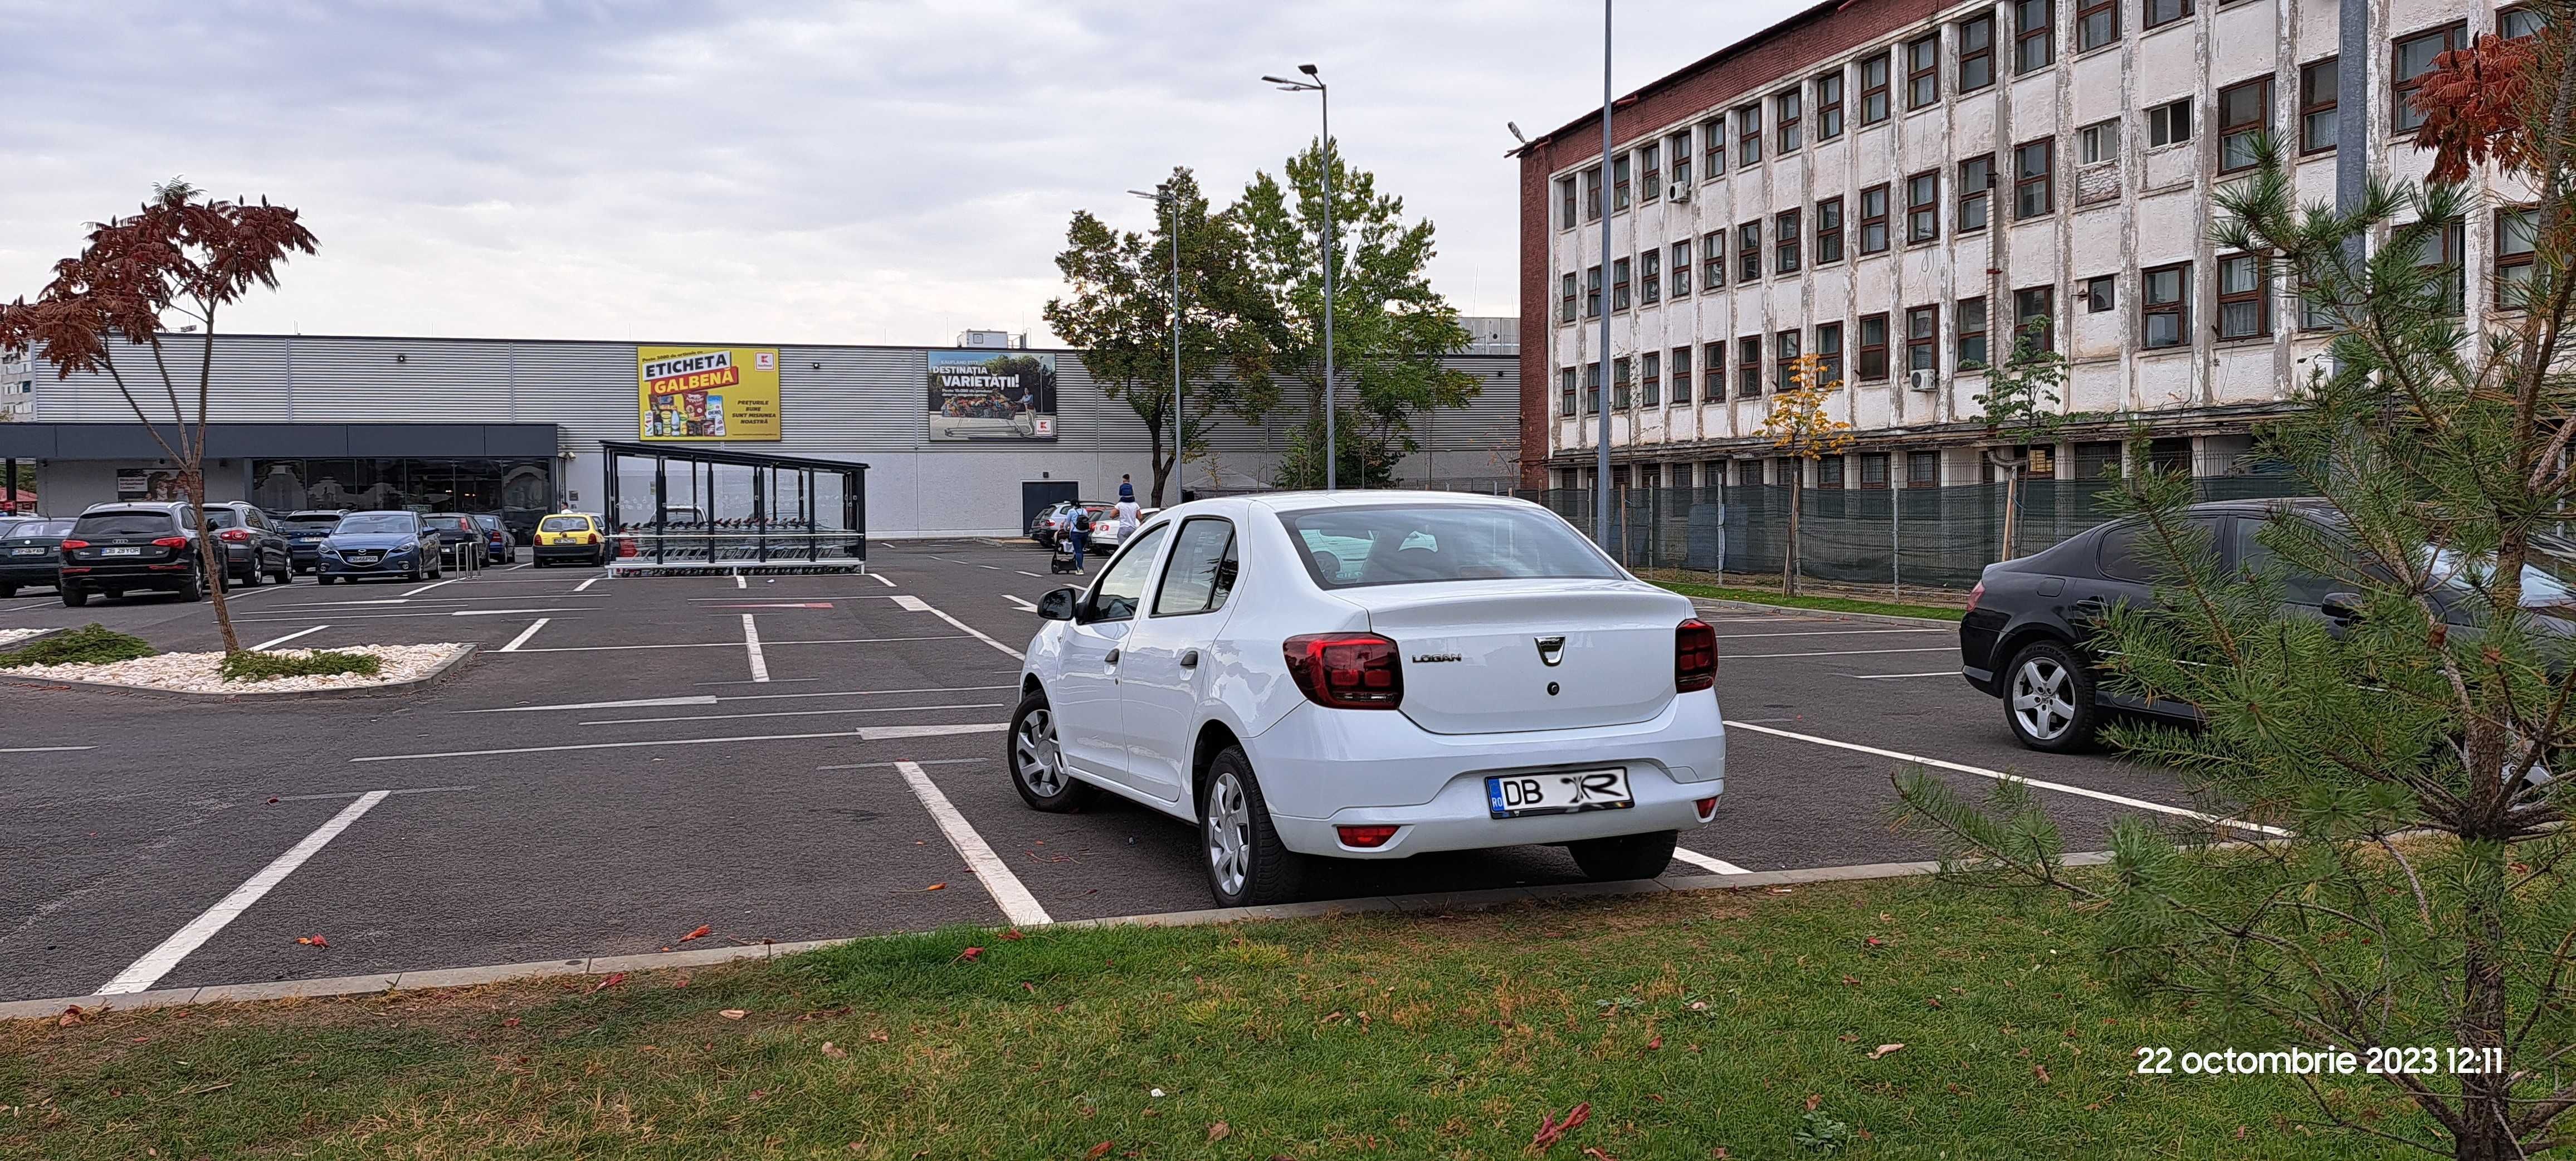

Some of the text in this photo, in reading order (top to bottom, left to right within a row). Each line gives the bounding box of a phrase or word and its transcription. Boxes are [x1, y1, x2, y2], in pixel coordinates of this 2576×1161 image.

[646, 354, 728, 378] ETICHETA
[933, 366, 988, 375] DESTINAȚIA
[654, 368, 734, 394] GALBENĂ
[942, 373, 1019, 391] VARIETĂȚII!
[1412, 653, 1462, 663] LOGAN
[1503, 779, 1543, 806] DB
[1492, 797, 1503, 808] RO
